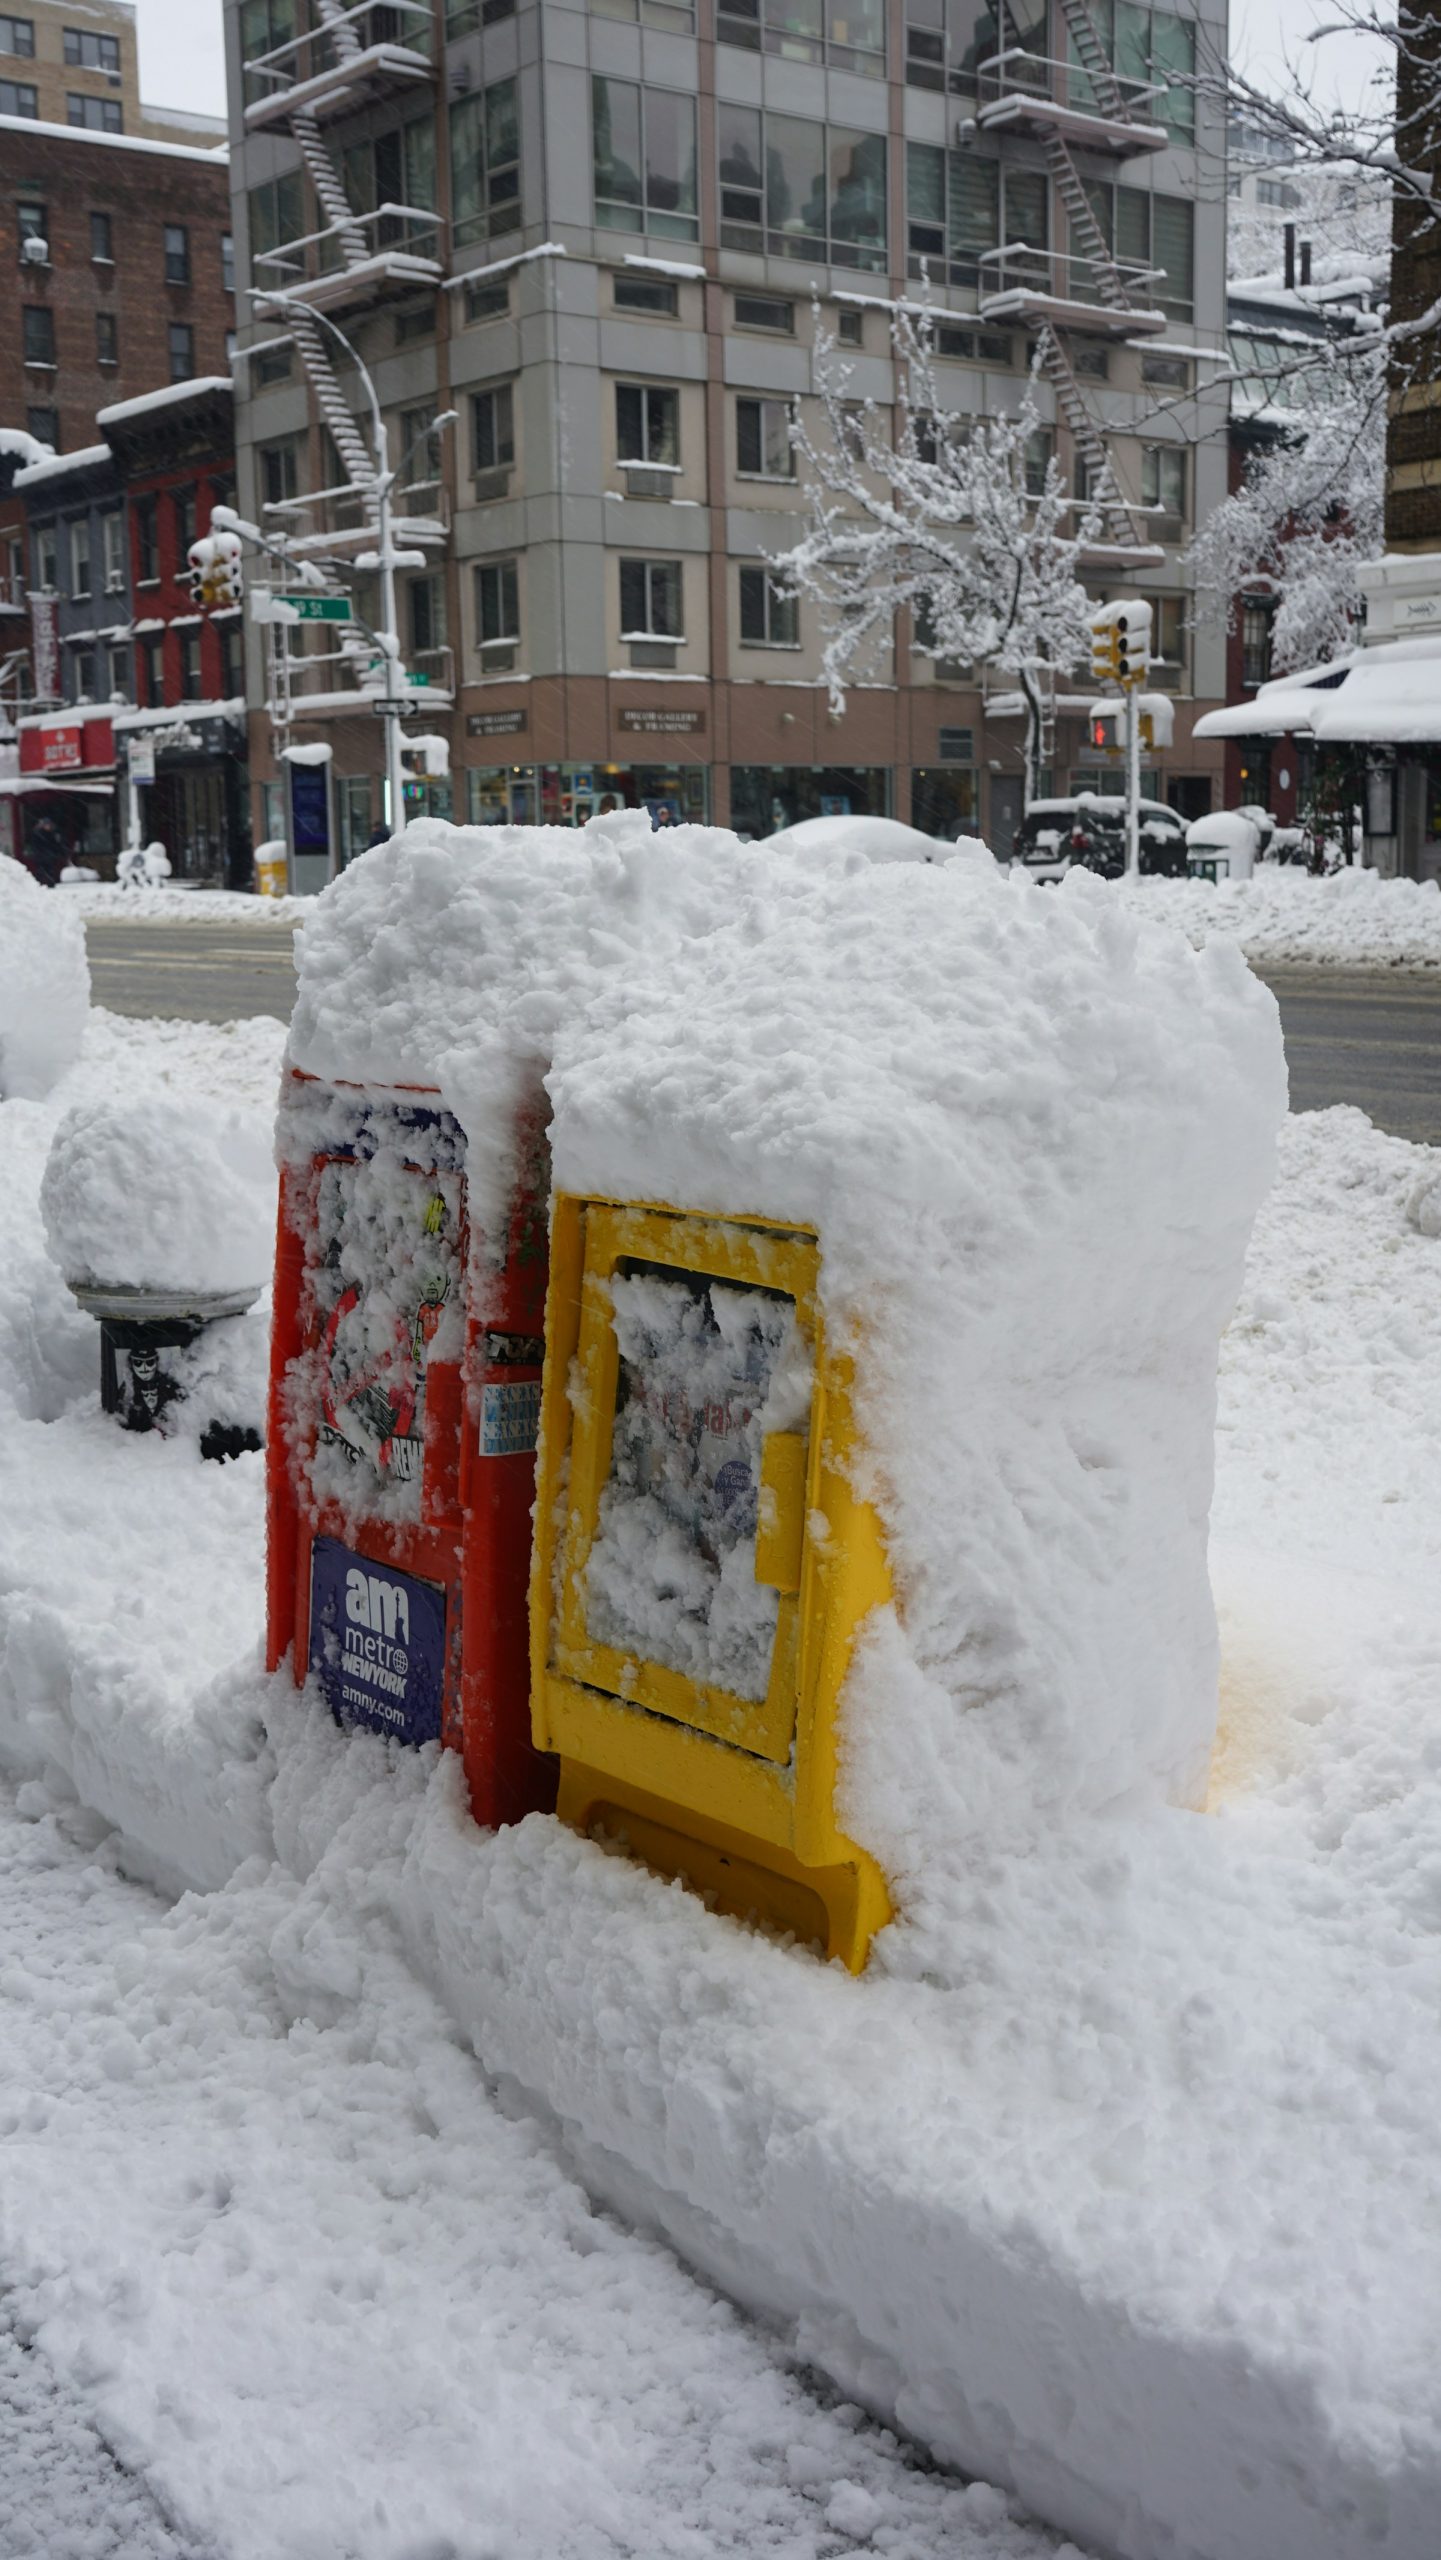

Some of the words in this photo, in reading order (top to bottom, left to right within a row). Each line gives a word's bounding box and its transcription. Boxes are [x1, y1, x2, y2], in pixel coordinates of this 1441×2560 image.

[309, 601, 323, 617] St
[345, 1568, 409, 1645] am
[345, 1626, 408, 1675] metro
[342, 1684, 405, 1727] amny.com
